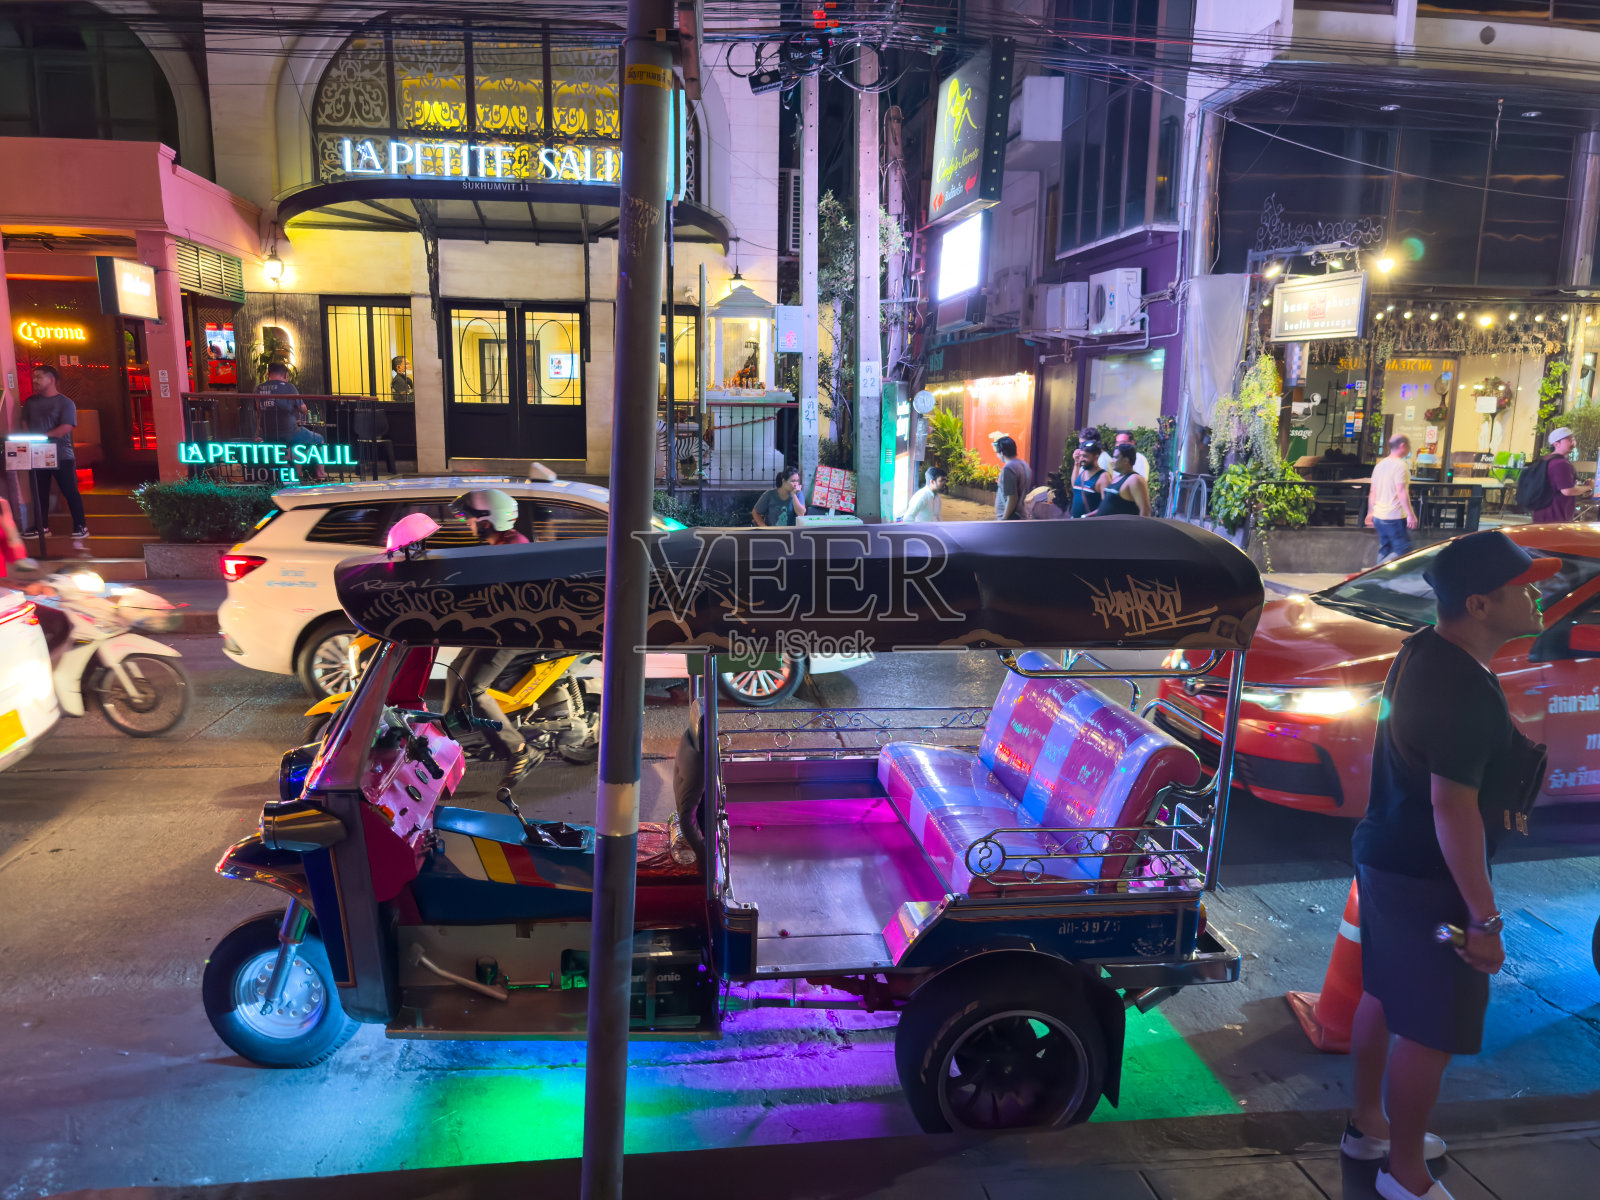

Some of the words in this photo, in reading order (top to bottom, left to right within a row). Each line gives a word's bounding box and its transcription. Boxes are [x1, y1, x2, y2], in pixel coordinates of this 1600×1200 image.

[343, 138, 385, 174] LA
[389, 141, 516, 179] PETITE
[462, 181, 516, 192] SUKHUMVIT
[520, 184, 529, 192] 11
[18, 321, 86, 344] Corona
[179, 442, 206, 464] LA
[208, 443, 288, 464] PETITE
[294, 444, 358, 465] SALIL
[244, 467, 300, 482] HOTEL
